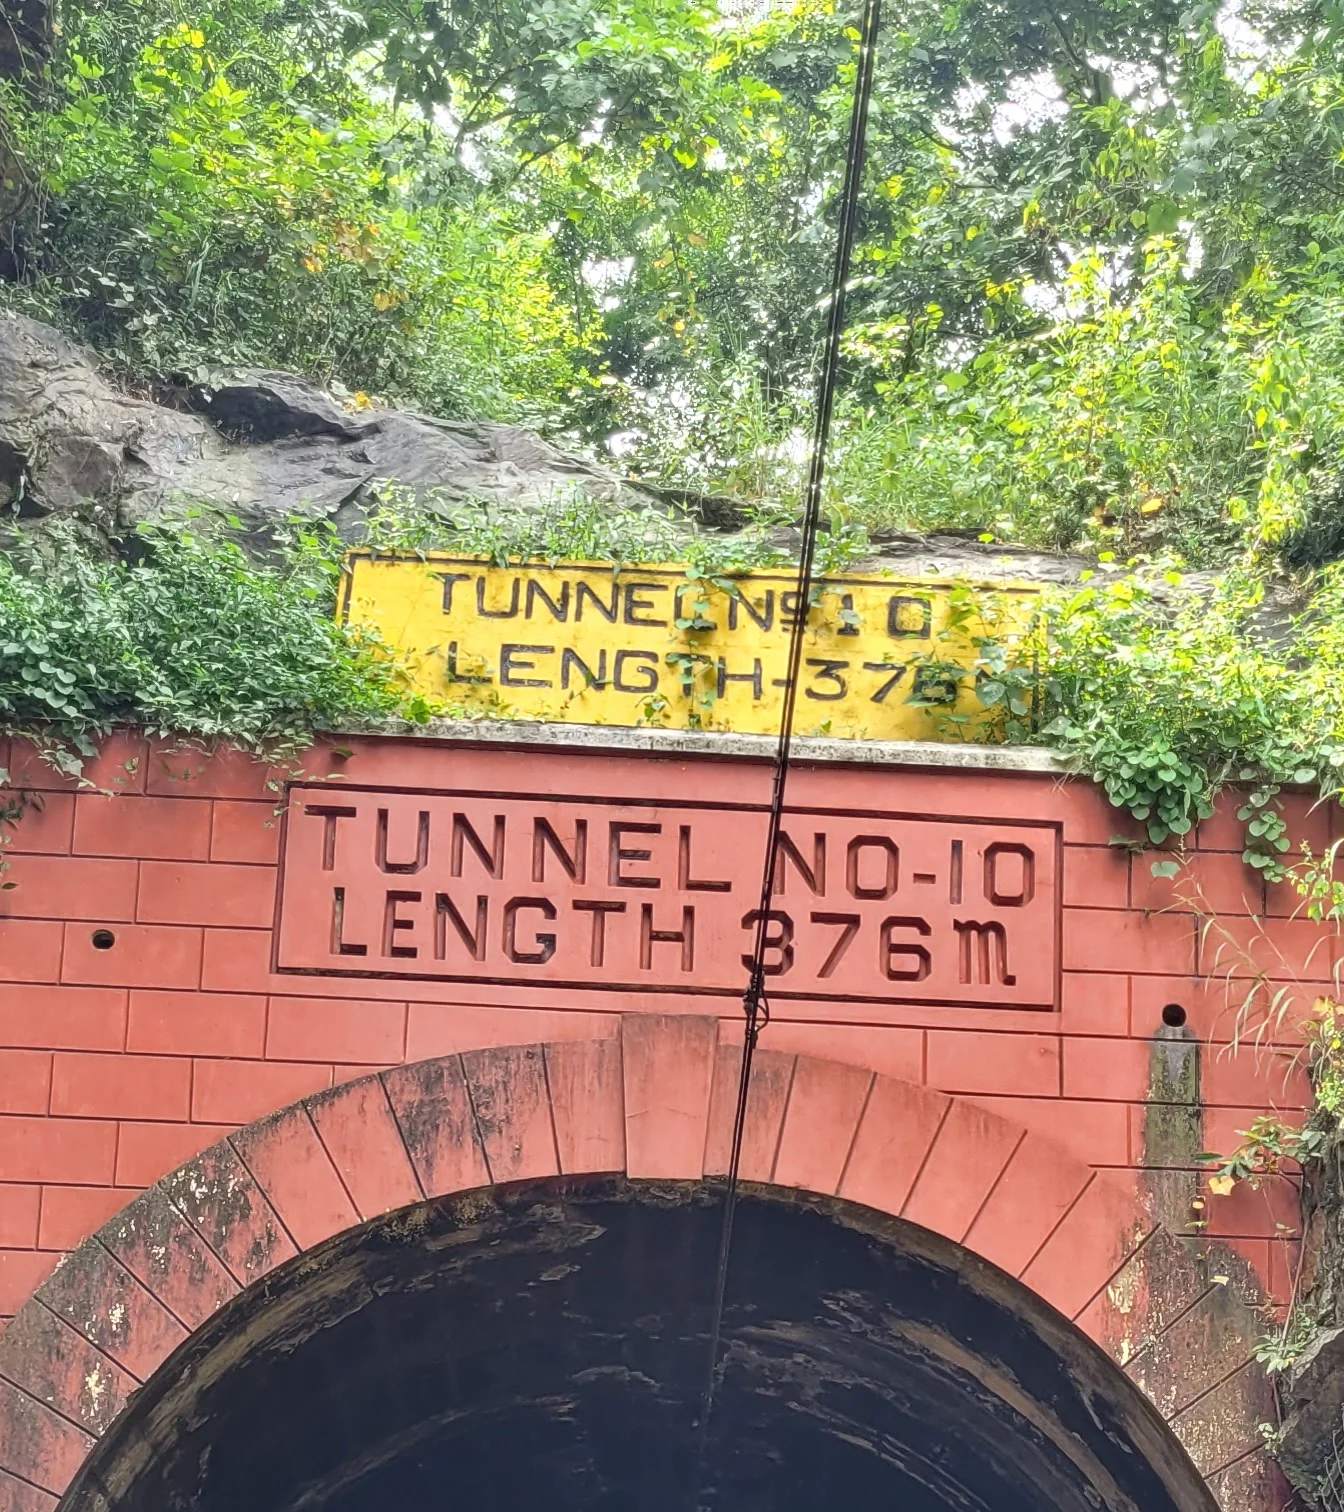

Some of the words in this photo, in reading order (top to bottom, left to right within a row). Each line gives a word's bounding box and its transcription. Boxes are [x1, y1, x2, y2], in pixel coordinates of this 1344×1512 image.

[435, 572, 718, 632] TUNNEL
[304, 804, 732, 893] TUNNEL
[329, 886, 695, 974] LENGTH
